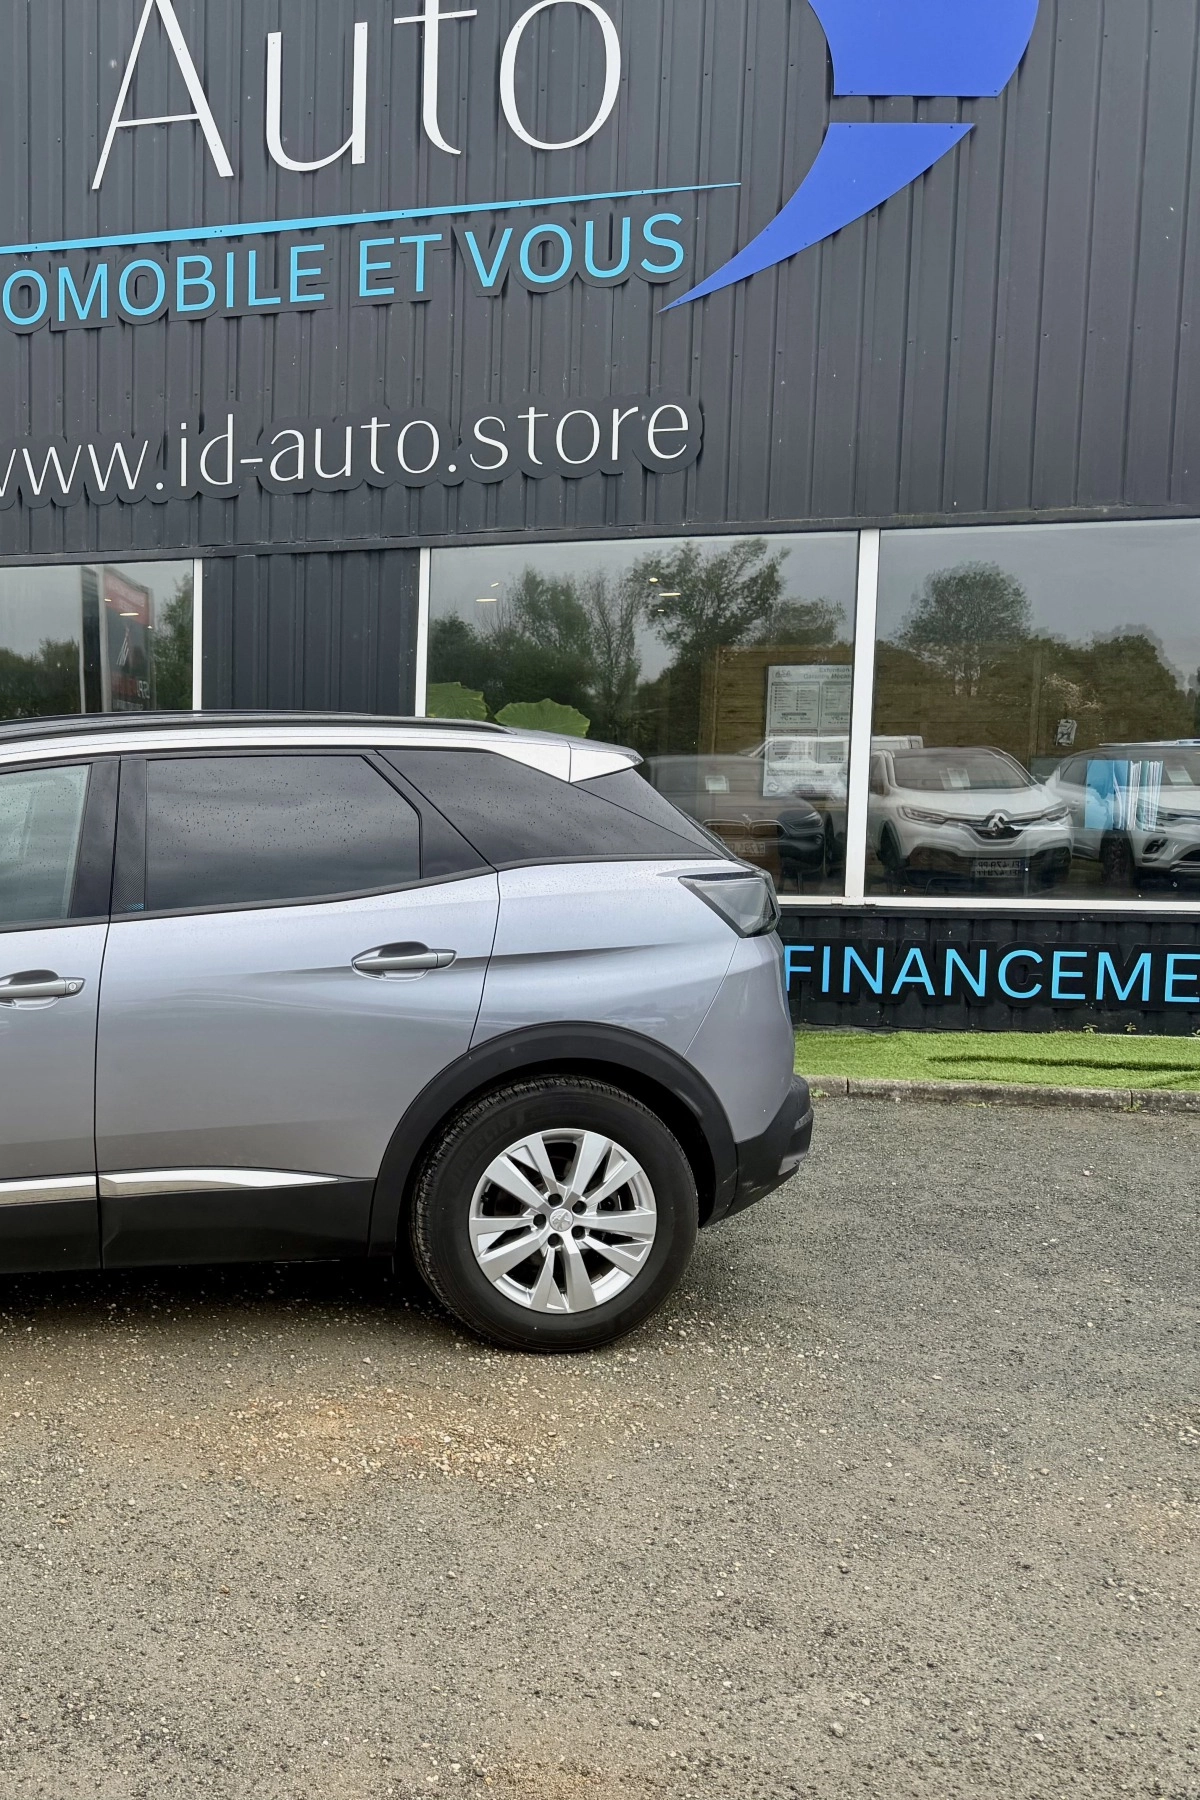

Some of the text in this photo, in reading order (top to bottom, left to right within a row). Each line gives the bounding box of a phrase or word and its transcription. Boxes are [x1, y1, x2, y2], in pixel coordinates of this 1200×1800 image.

[90, 0, 622, 190] Auto
[359, 233, 443, 297] ET
[465, 212, 685, 288] VOUS
[784, 945, 1200, 1002] FINANCEME
